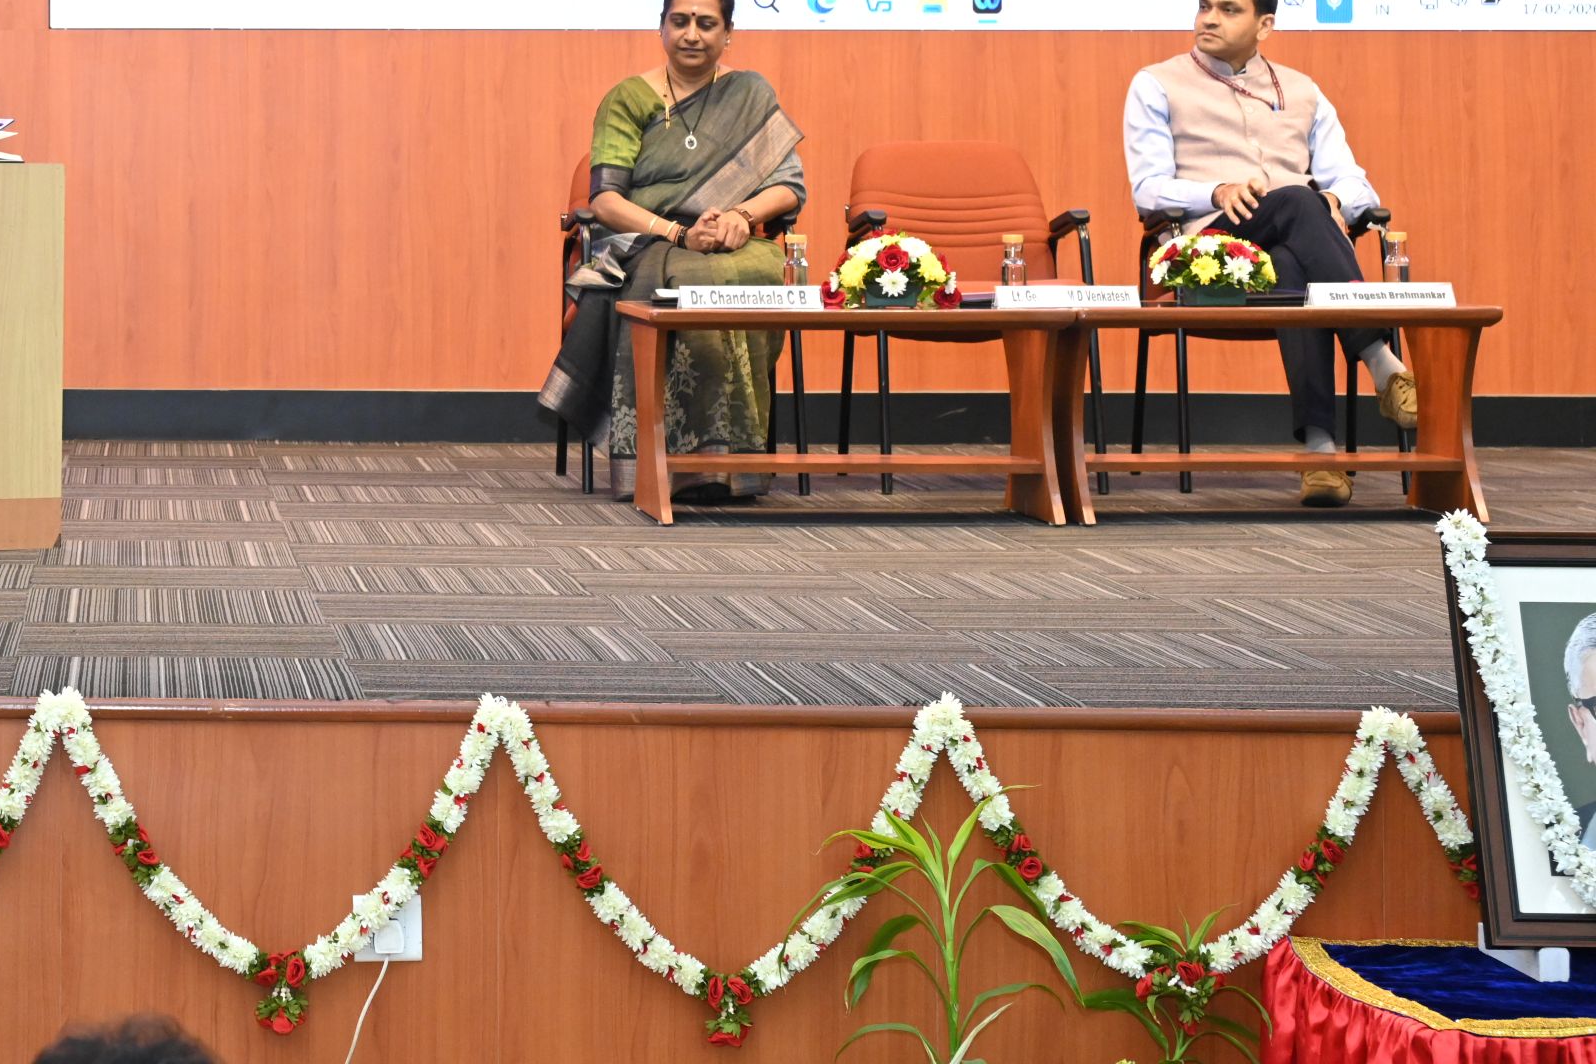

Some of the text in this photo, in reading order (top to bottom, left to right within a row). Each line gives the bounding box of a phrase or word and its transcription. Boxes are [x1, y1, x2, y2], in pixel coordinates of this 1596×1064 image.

[690, 290, 807, 305] Dr. Chandrakala C B
[1085, 291, 1130, 302] Venkatesh
[1353, 292, 1387, 300] Yogesh
